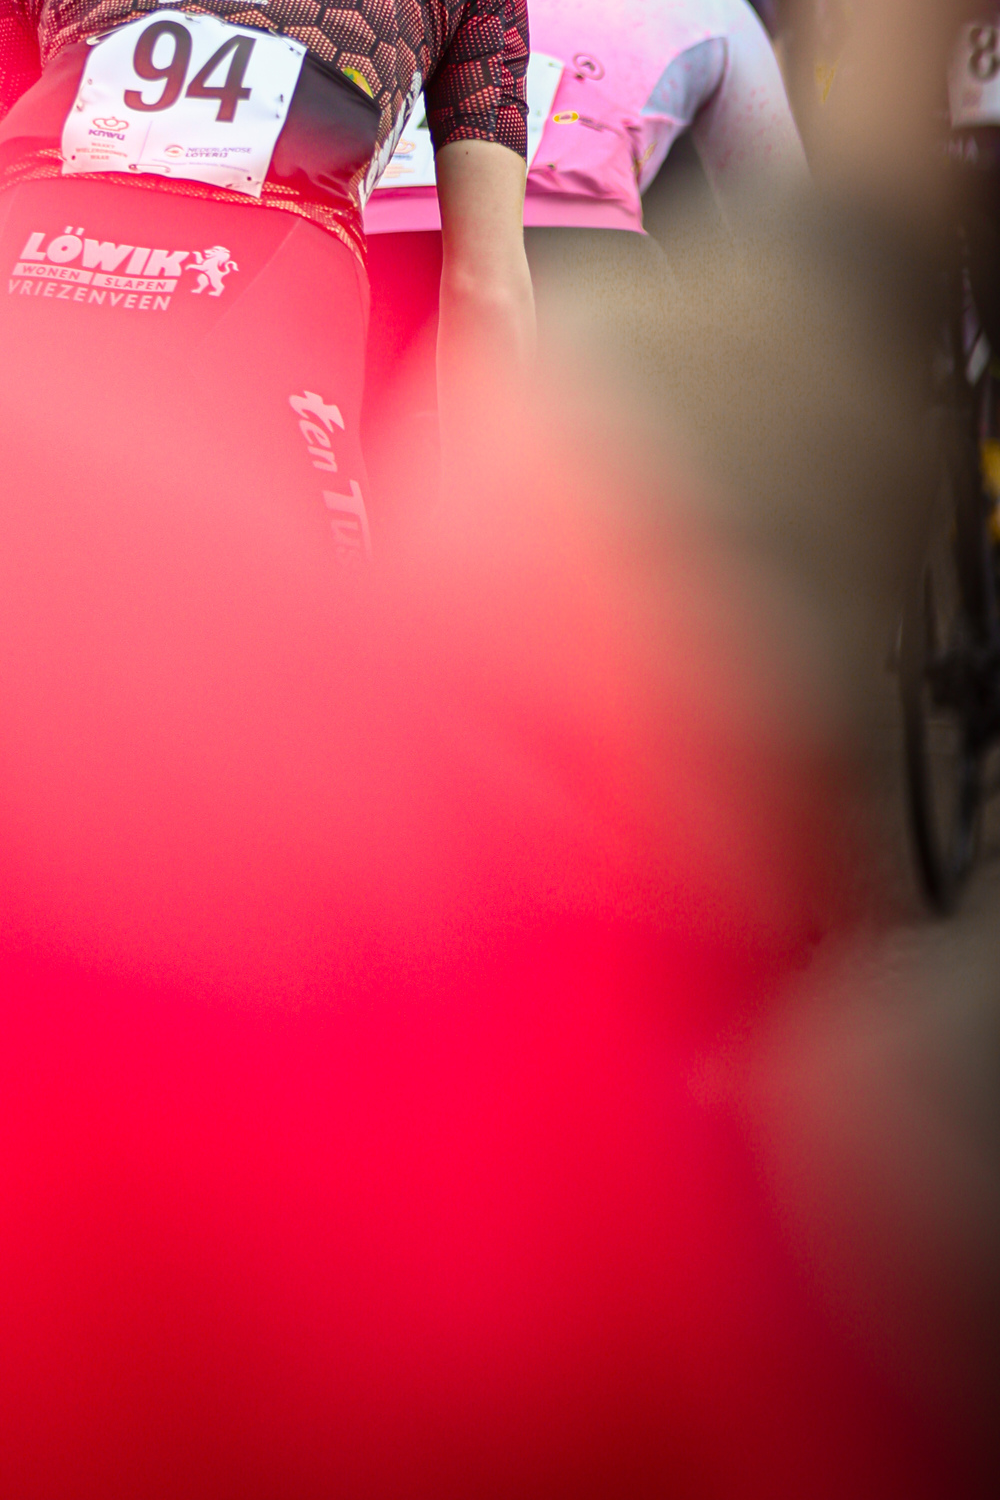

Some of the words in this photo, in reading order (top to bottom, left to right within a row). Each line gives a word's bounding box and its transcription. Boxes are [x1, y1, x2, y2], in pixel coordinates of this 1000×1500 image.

[124, 19, 257, 124] 94
[185, 151, 228, 159] LOTERIJ
[187, 147, 252, 155] NEDERLANDSE
[20, 225, 190, 277] LÖWIK
[22, 264, 81, 280] WONEN
[104, 277, 167, 291] SLAPEN
[8, 279, 171, 311] VRIEZENVEEN
[288, 390, 345, 473] ten
